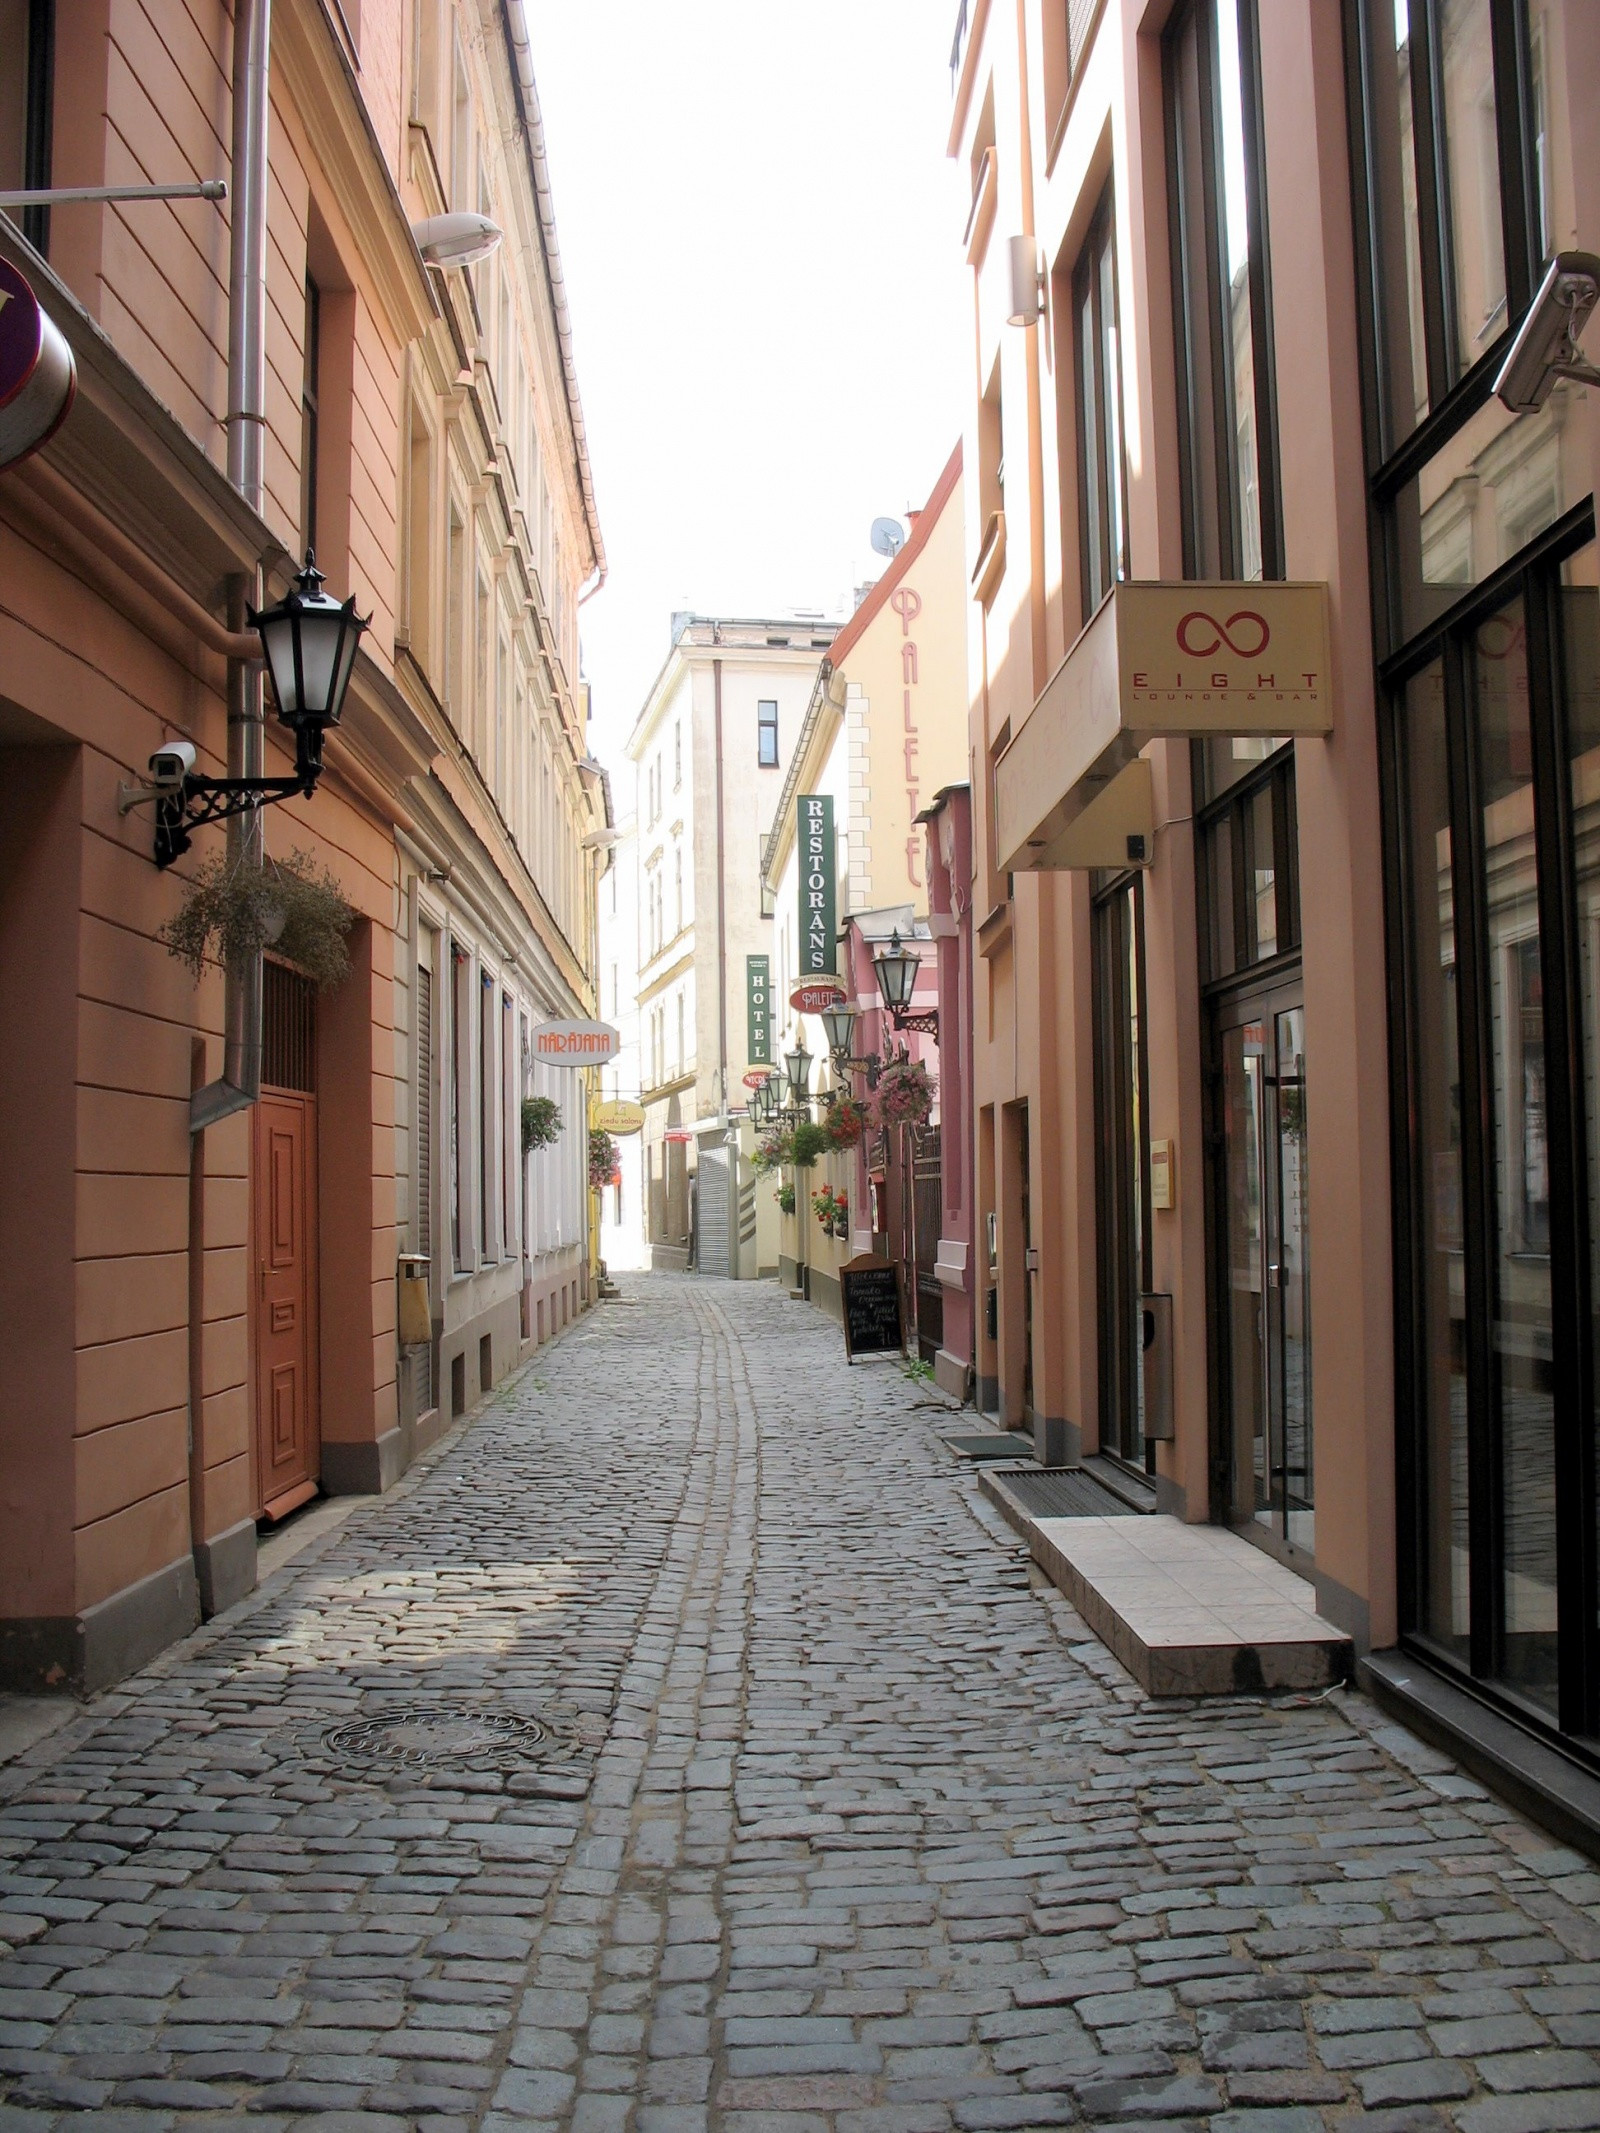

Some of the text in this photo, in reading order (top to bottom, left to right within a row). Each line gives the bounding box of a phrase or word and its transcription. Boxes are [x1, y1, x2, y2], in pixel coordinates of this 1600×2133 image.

[1133, 673, 1317, 687] EIGHT
[1247, 692, 1256, 700] &
[807, 800, 826, 968] RESTORĀNS
[752, 975, 765, 1058] HOTEL
[600, 1117, 642, 1125] ziedu salons
